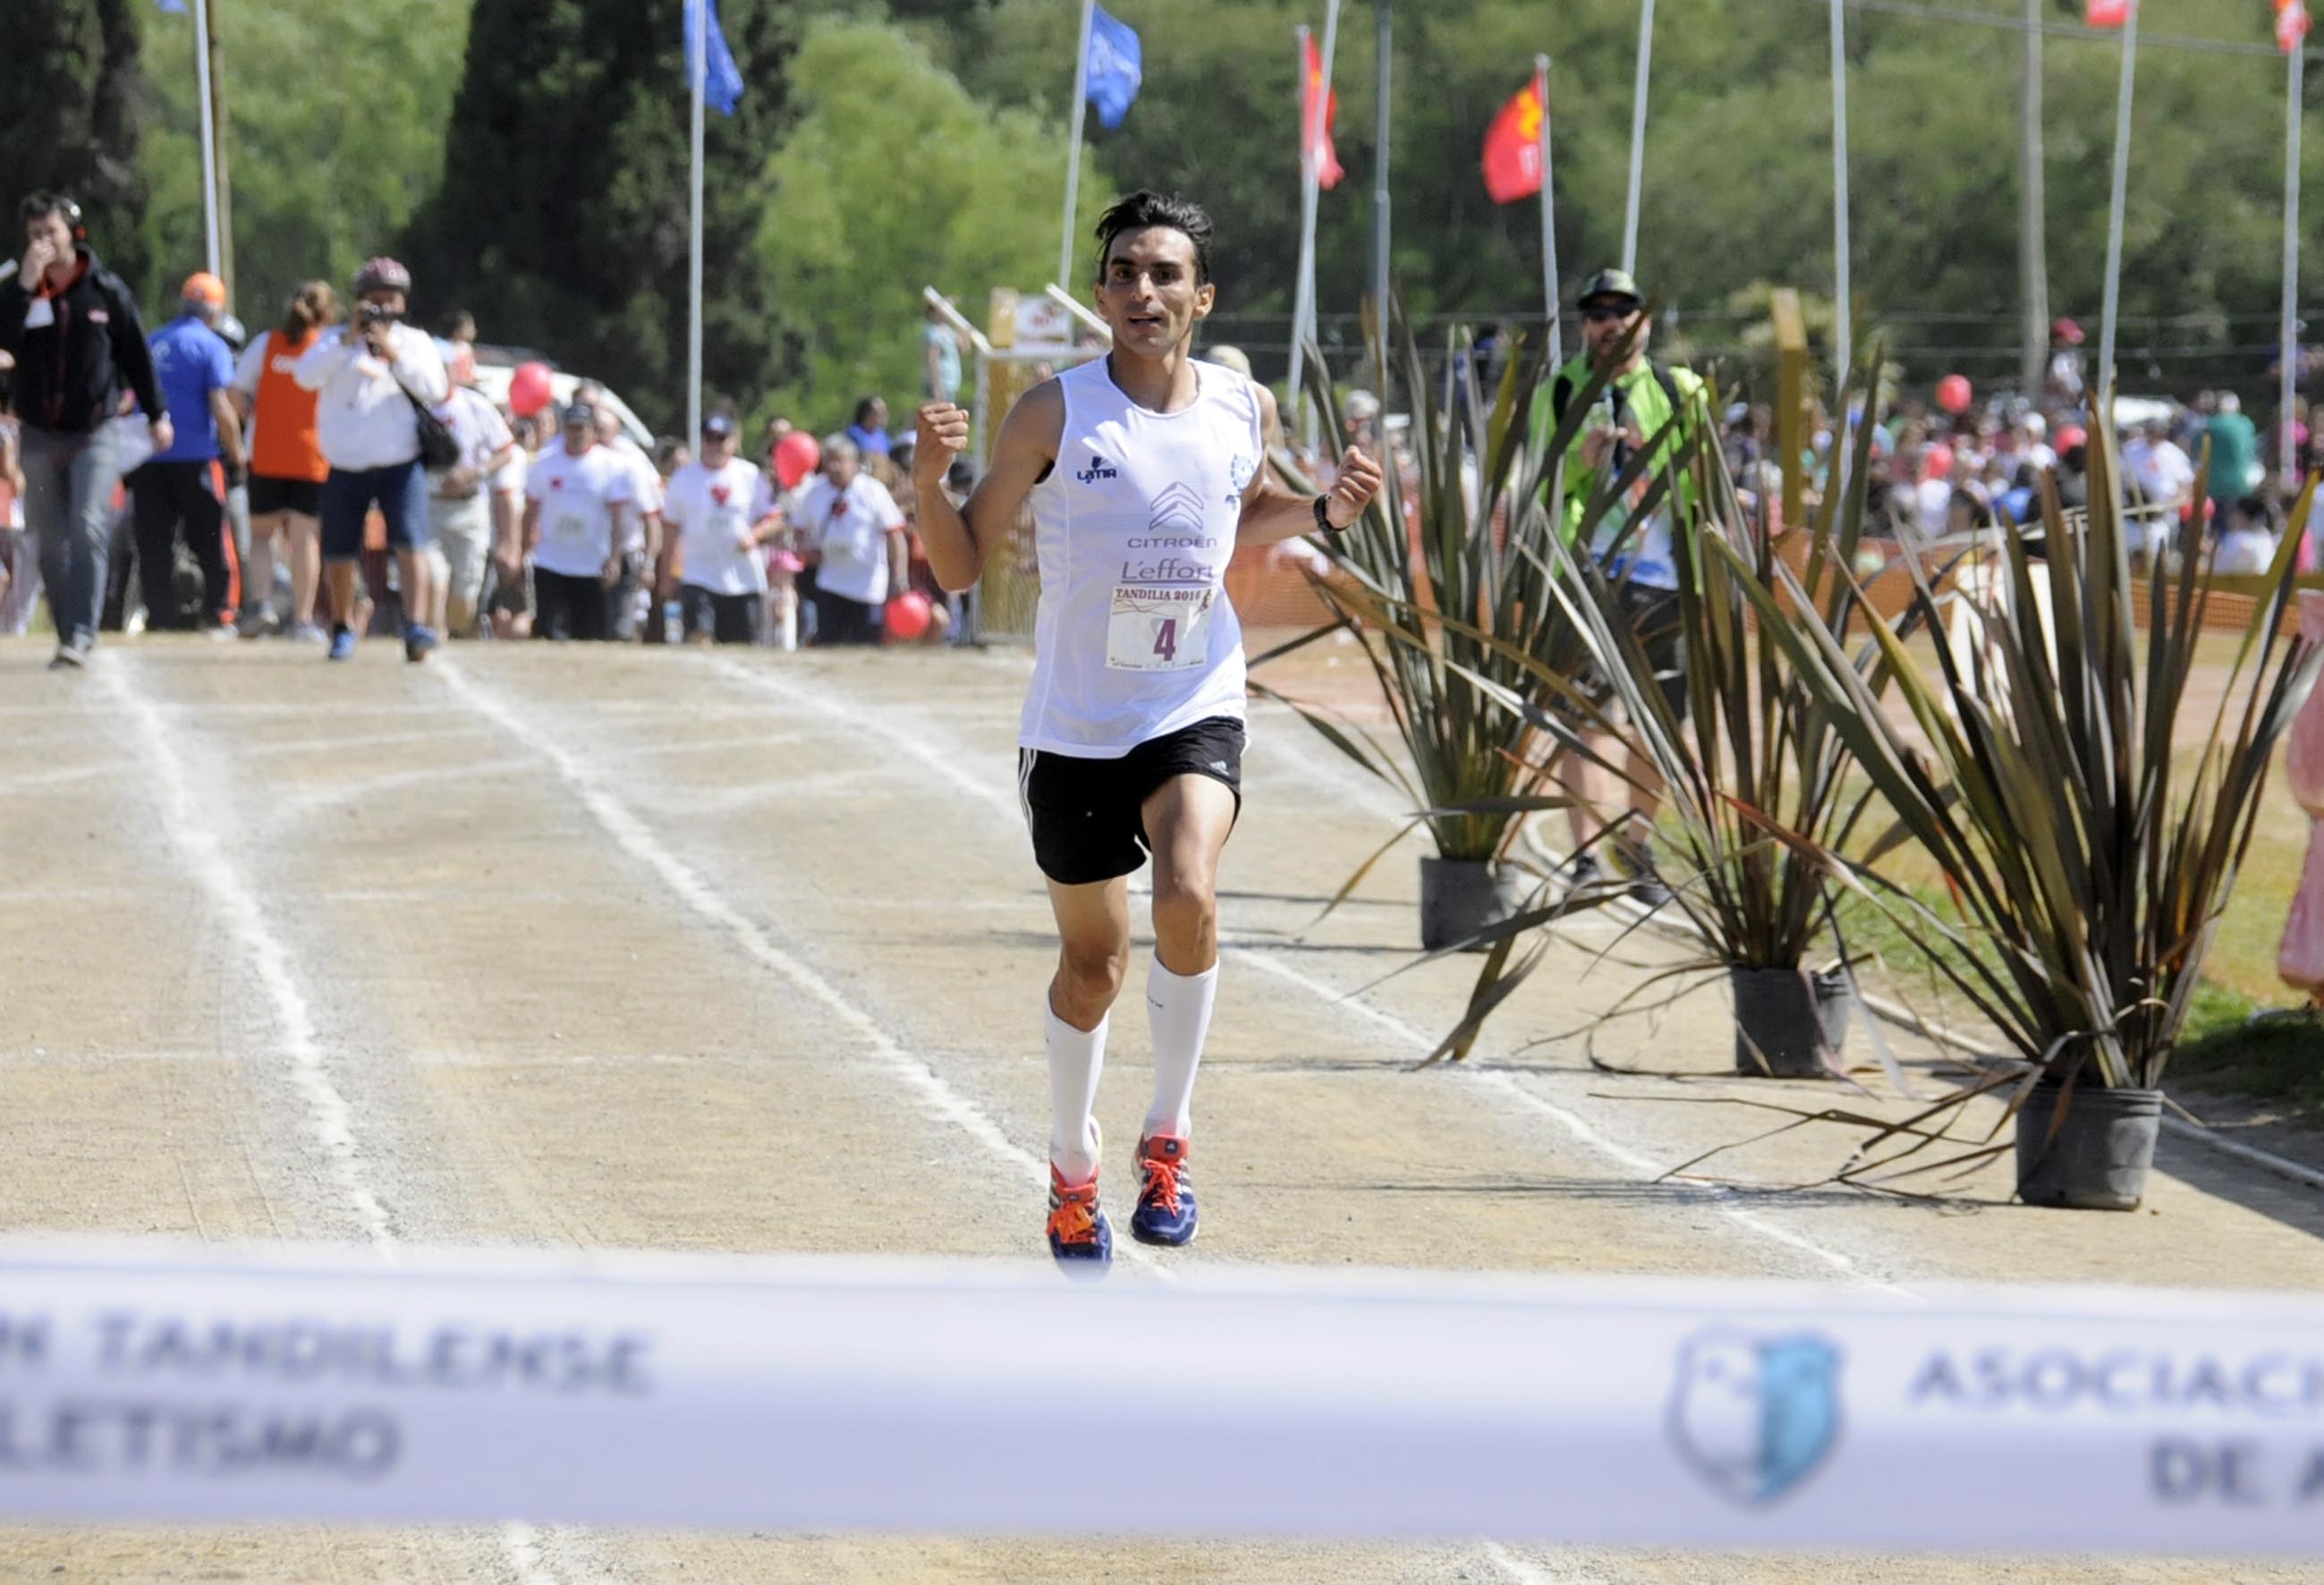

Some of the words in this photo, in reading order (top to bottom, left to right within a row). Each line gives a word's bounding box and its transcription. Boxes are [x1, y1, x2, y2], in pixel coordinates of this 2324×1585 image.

[1115, 589, 1171, 600] TANDILIA
[1153, 618, 1176, 661] 4
[94, 1310, 655, 1396] TANDILENSE
[2150, 1436, 2263, 1504] DE
